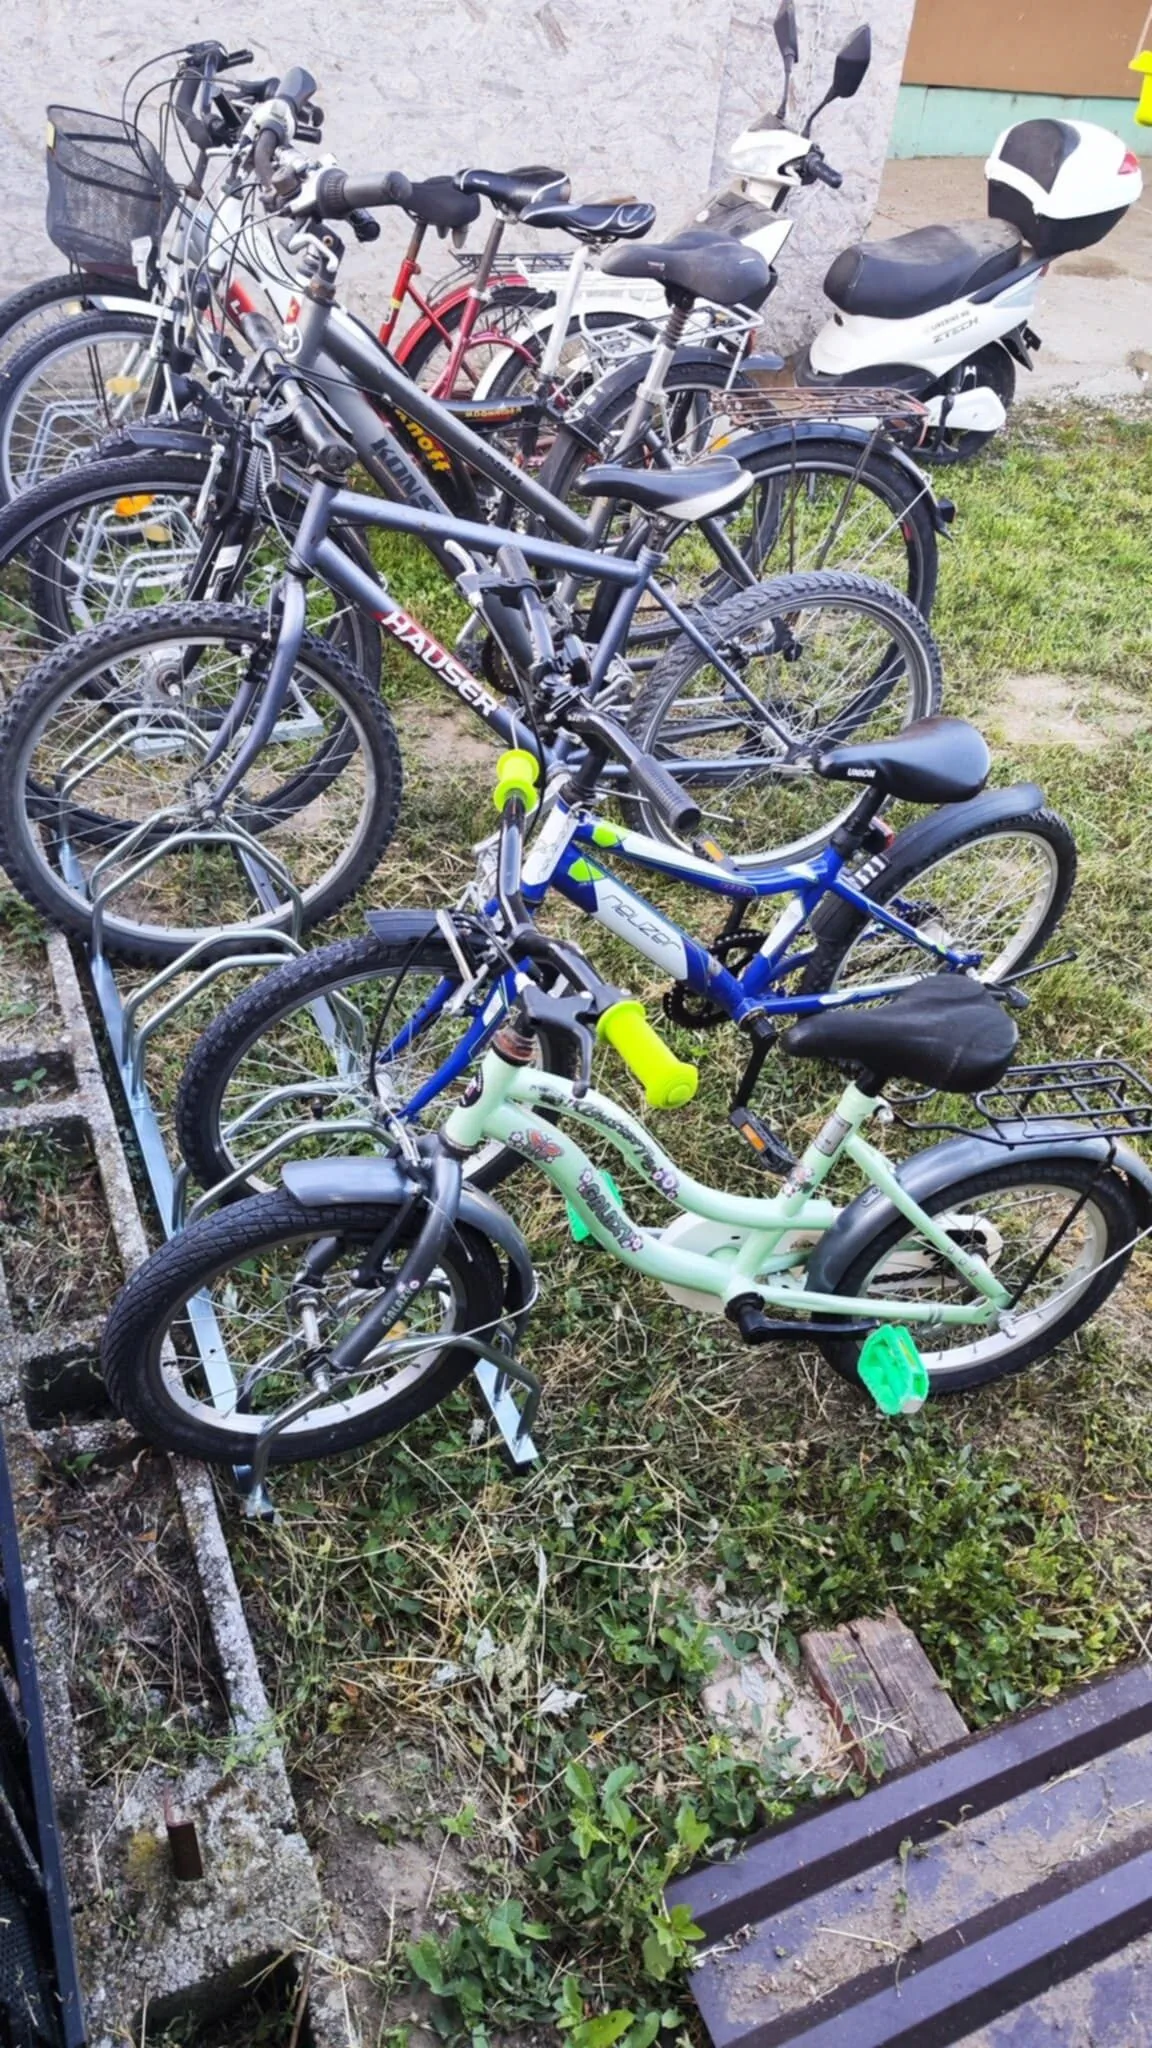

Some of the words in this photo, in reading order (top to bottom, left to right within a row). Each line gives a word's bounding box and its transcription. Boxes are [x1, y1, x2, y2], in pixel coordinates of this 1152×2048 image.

[381, 610, 498, 717] HAUSER
[847, 767, 876, 778] UNION
[579, 1183, 632, 1243] GALAXY
[381, 1287, 413, 1326] GALAXY
